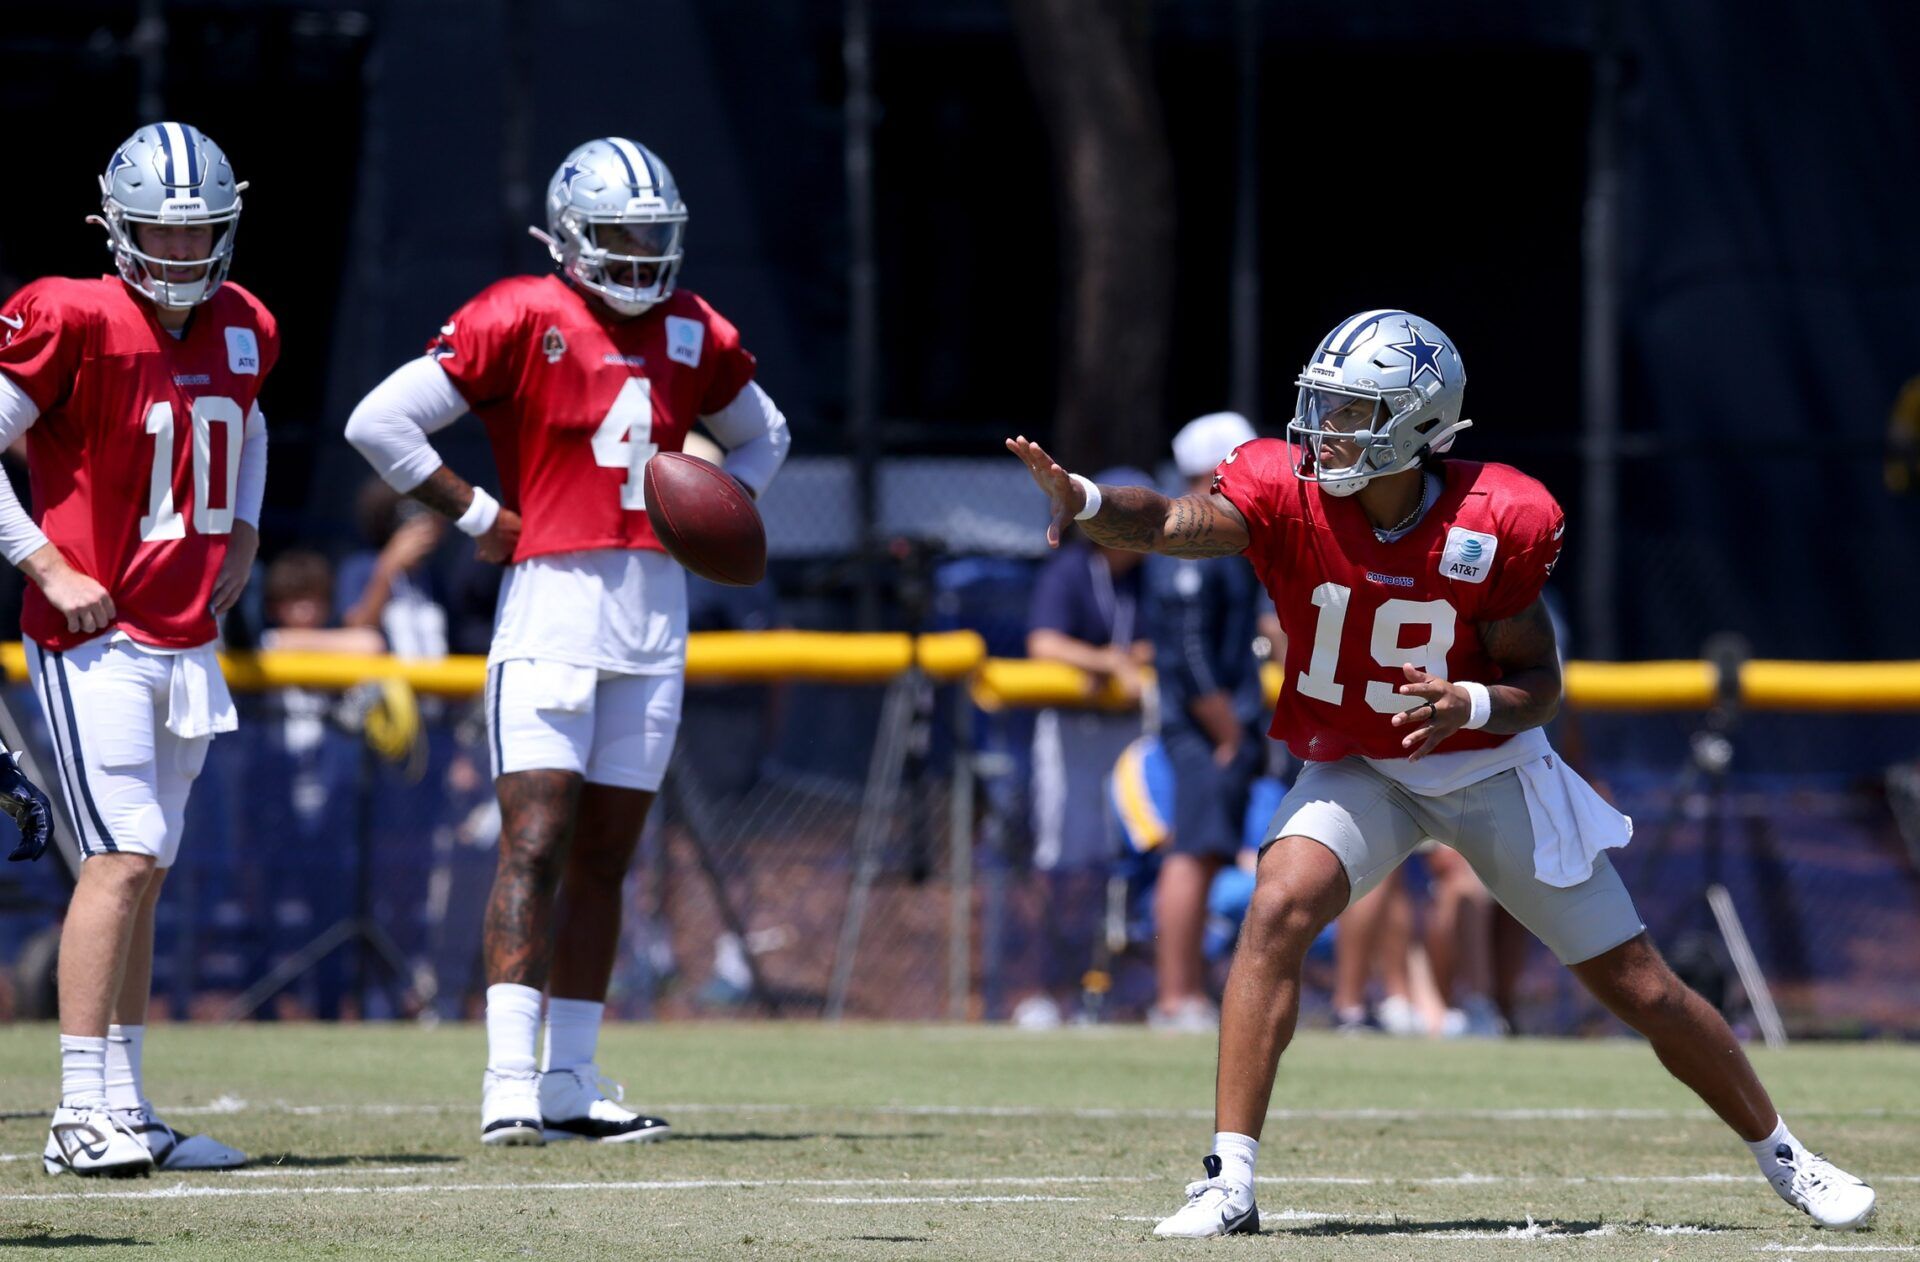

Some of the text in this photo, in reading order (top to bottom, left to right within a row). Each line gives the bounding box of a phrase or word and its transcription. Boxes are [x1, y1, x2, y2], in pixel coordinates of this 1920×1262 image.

[140, 396, 243, 542] 10
[591, 376, 658, 511] 4
[1366, 572, 1414, 587] COWBOYS
[1449, 562, 1480, 577] AT&T
[1296, 582, 1457, 714] 19
